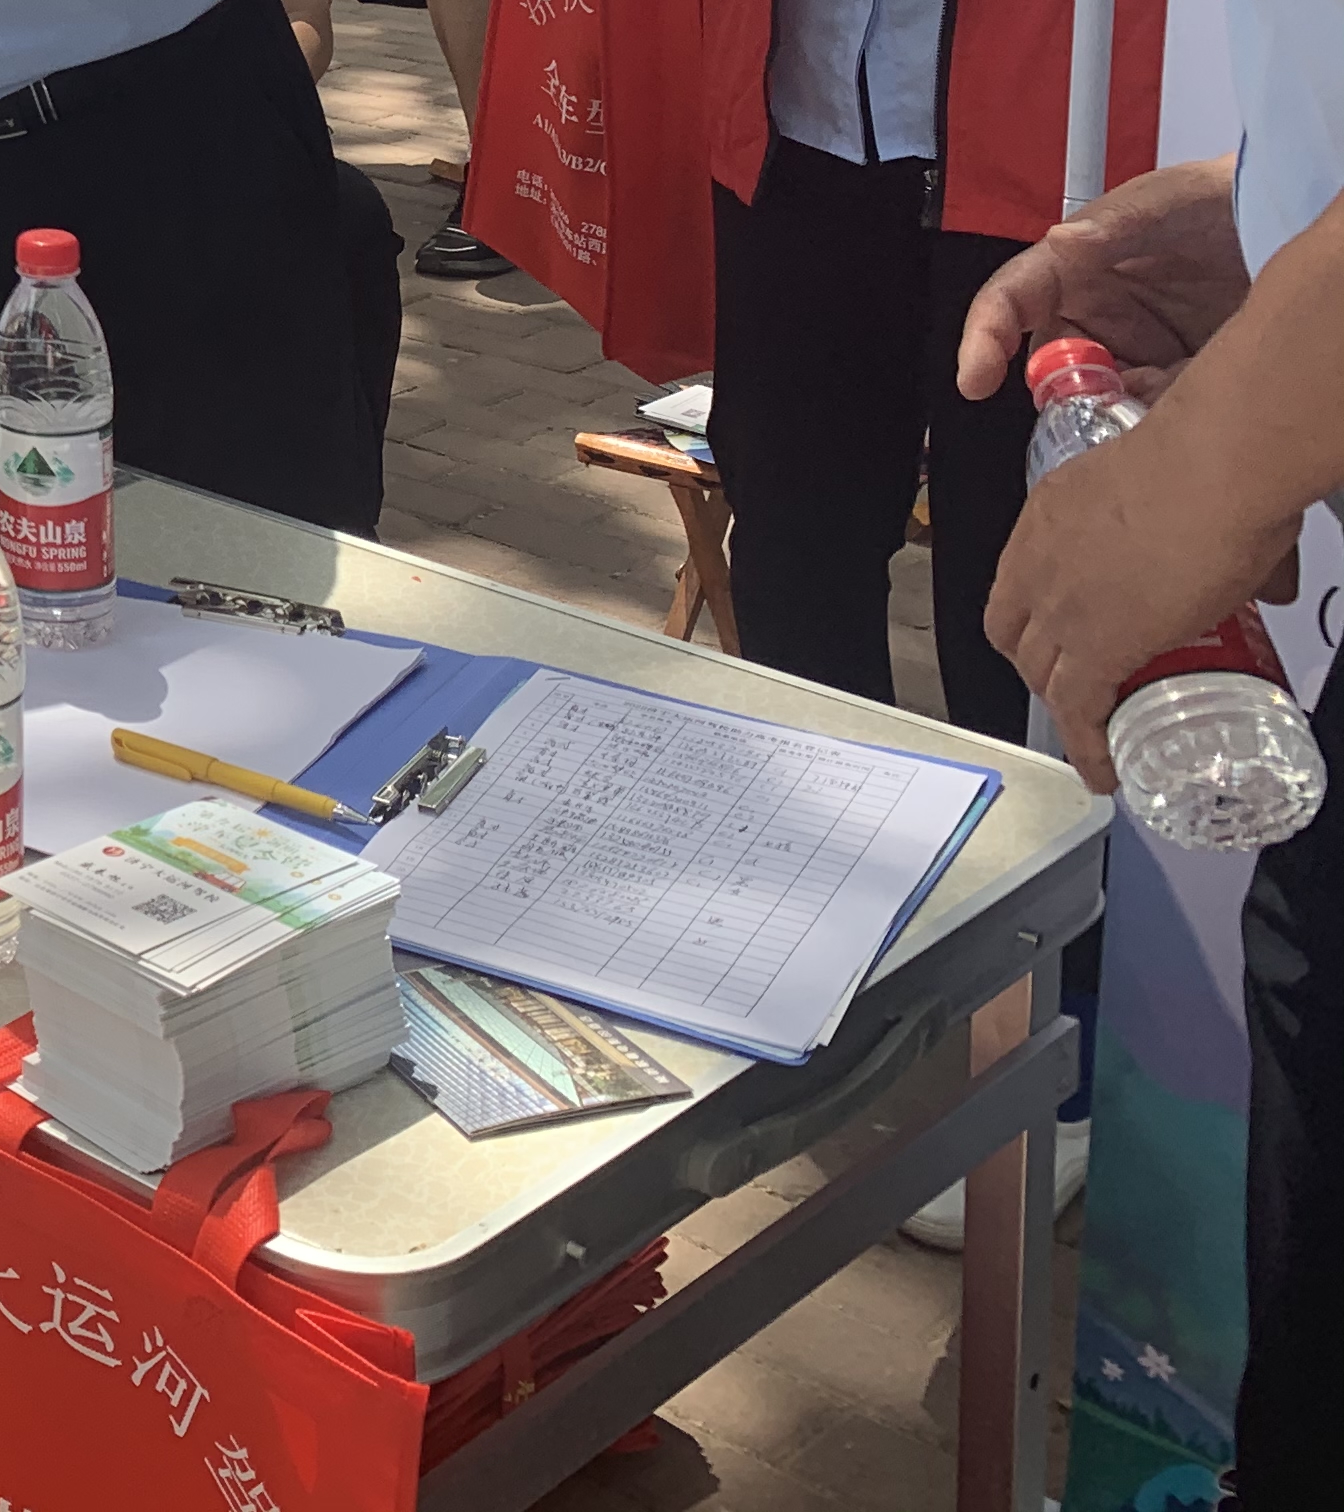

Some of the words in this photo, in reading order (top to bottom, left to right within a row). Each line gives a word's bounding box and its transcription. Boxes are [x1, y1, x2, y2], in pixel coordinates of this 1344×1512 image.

[0, 509, 87, 545] 农夫山泉
[42, 545, 87, 561] SPRING
